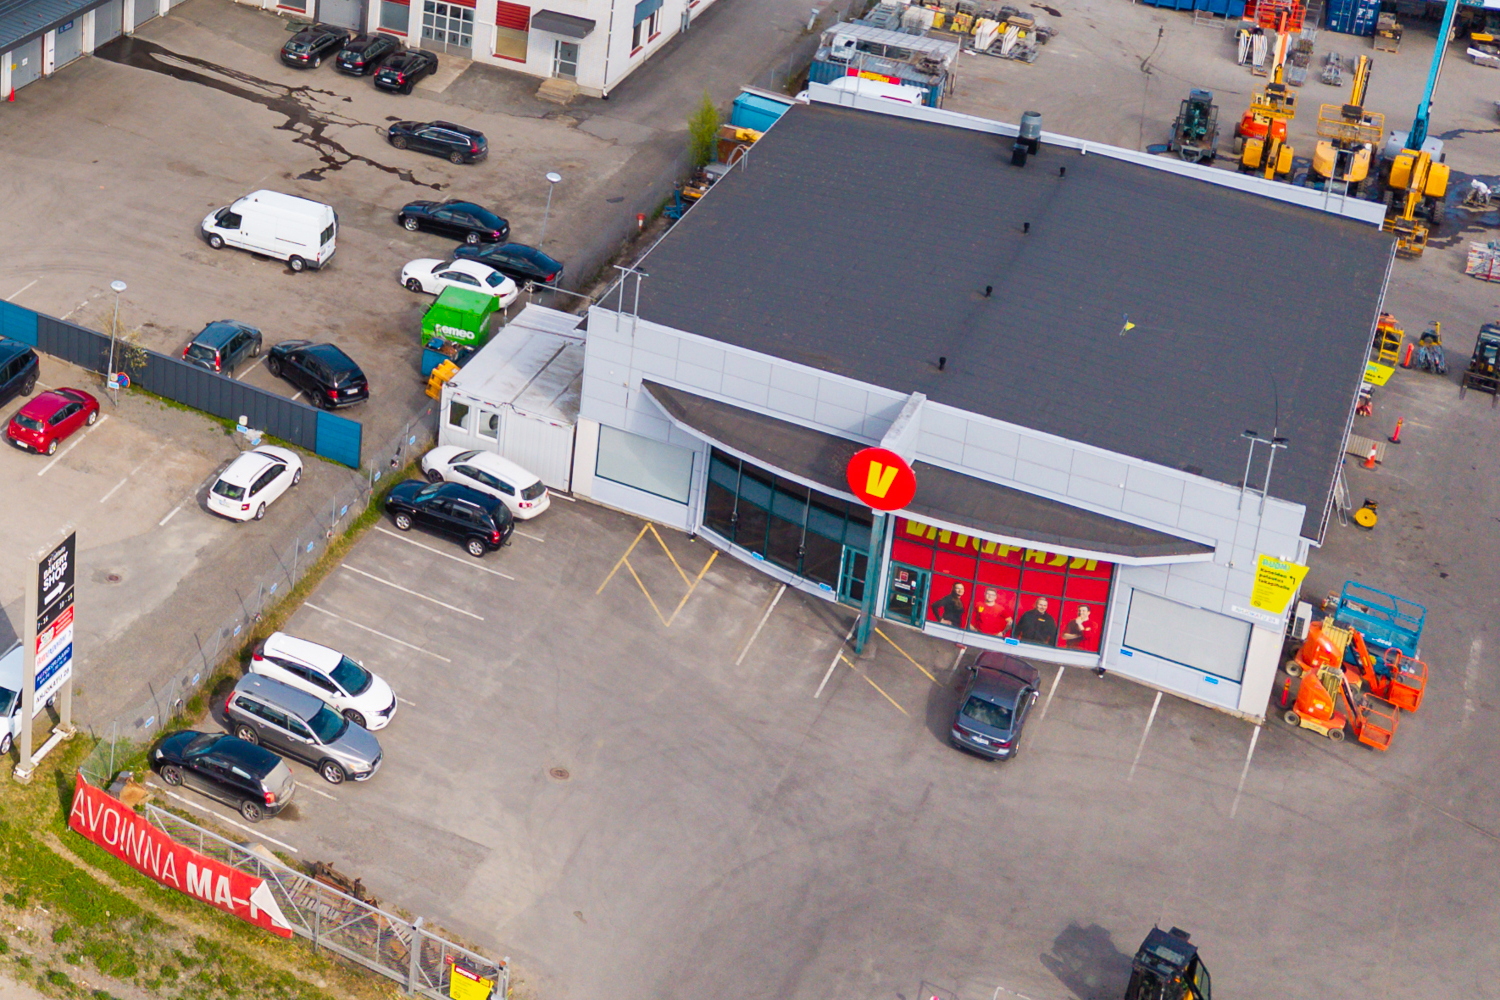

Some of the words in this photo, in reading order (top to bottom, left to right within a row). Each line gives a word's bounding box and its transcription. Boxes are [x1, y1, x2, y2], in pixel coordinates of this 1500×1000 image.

[866, 460, 899, 498] V
[43, 551, 68, 580] BAKERY
[43, 561, 67, 592] SHOP
[71, 788, 180, 888] AVOINNA
[186, 861, 283, 928] MA-
